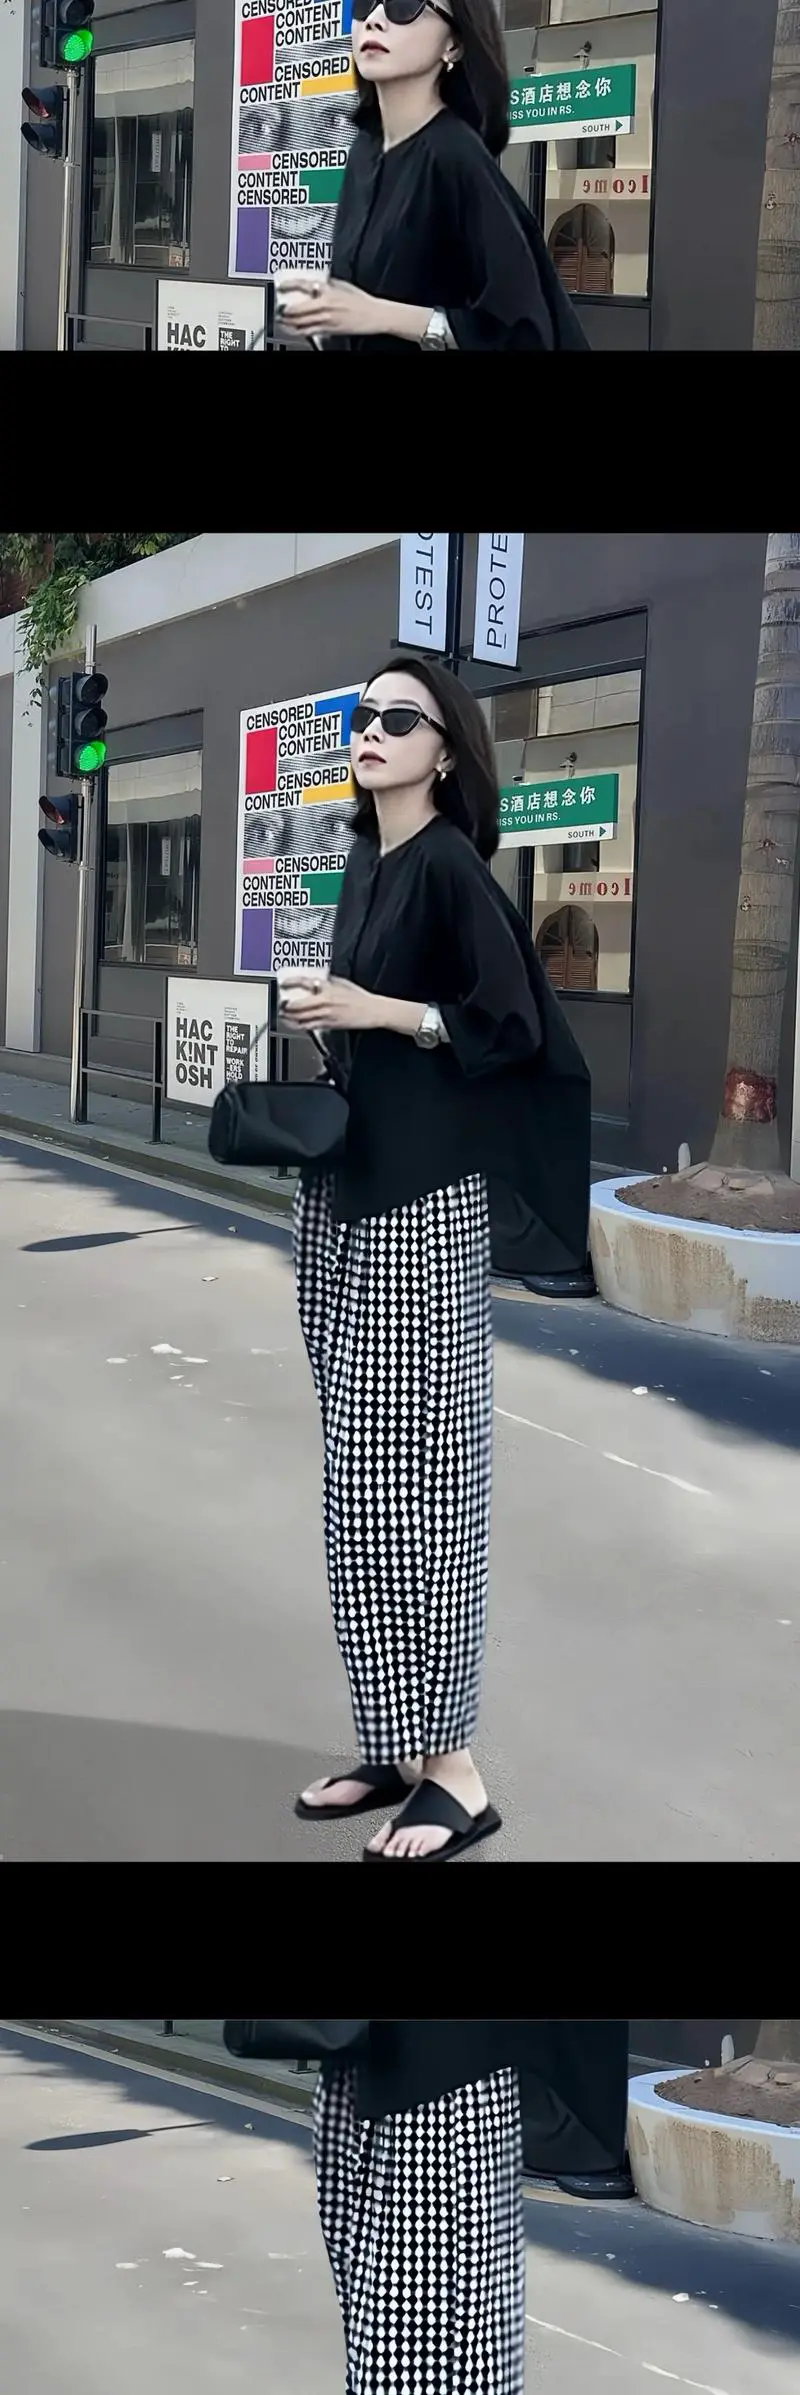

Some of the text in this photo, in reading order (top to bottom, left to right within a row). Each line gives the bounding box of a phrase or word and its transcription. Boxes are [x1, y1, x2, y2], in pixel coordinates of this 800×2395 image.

[276, 1, 340, 29] CONTENT
[275, 20, 340, 47] CONTENT
[275, 56, 350, 82] CENSORED
[240, 82, 300, 104] CONTENT
[508, 104, 575, 120] ISS YOU IN RS.
[581, 124, 610, 133] SOUTH
[272, 150, 347, 169] CENSORED
[238, 171, 298, 188] CONTENT
[237, 189, 307, 205] CENSORED
[270, 241, 333, 259] CONTENT
[167, 322, 206, 348] HAC
[220, 331, 233, 339] THE
[246, 703, 314, 730] CENSORED
[279, 714, 340, 740] CONTENT
[279, 732, 340, 757] CONTENT
[277, 766, 349, 790] CENSORED
[245, 790, 302, 811] CONTENT
[497, 811, 561, 827] ISS YOU IN RS.
[567, 830, 595, 839] SOUTH
[275, 854, 346, 873] CENSORED
[243, 874, 300, 890] CONTENT
[242, 891, 308, 907] CENSORED
[273, 940, 333, 957] CONTENT
[176, 1017, 213, 1041] HAC
[226, 1025, 239, 1033] THE
[176, 1040, 218, 1066] K!NT
[175, 1063, 213, 1089] OSH
